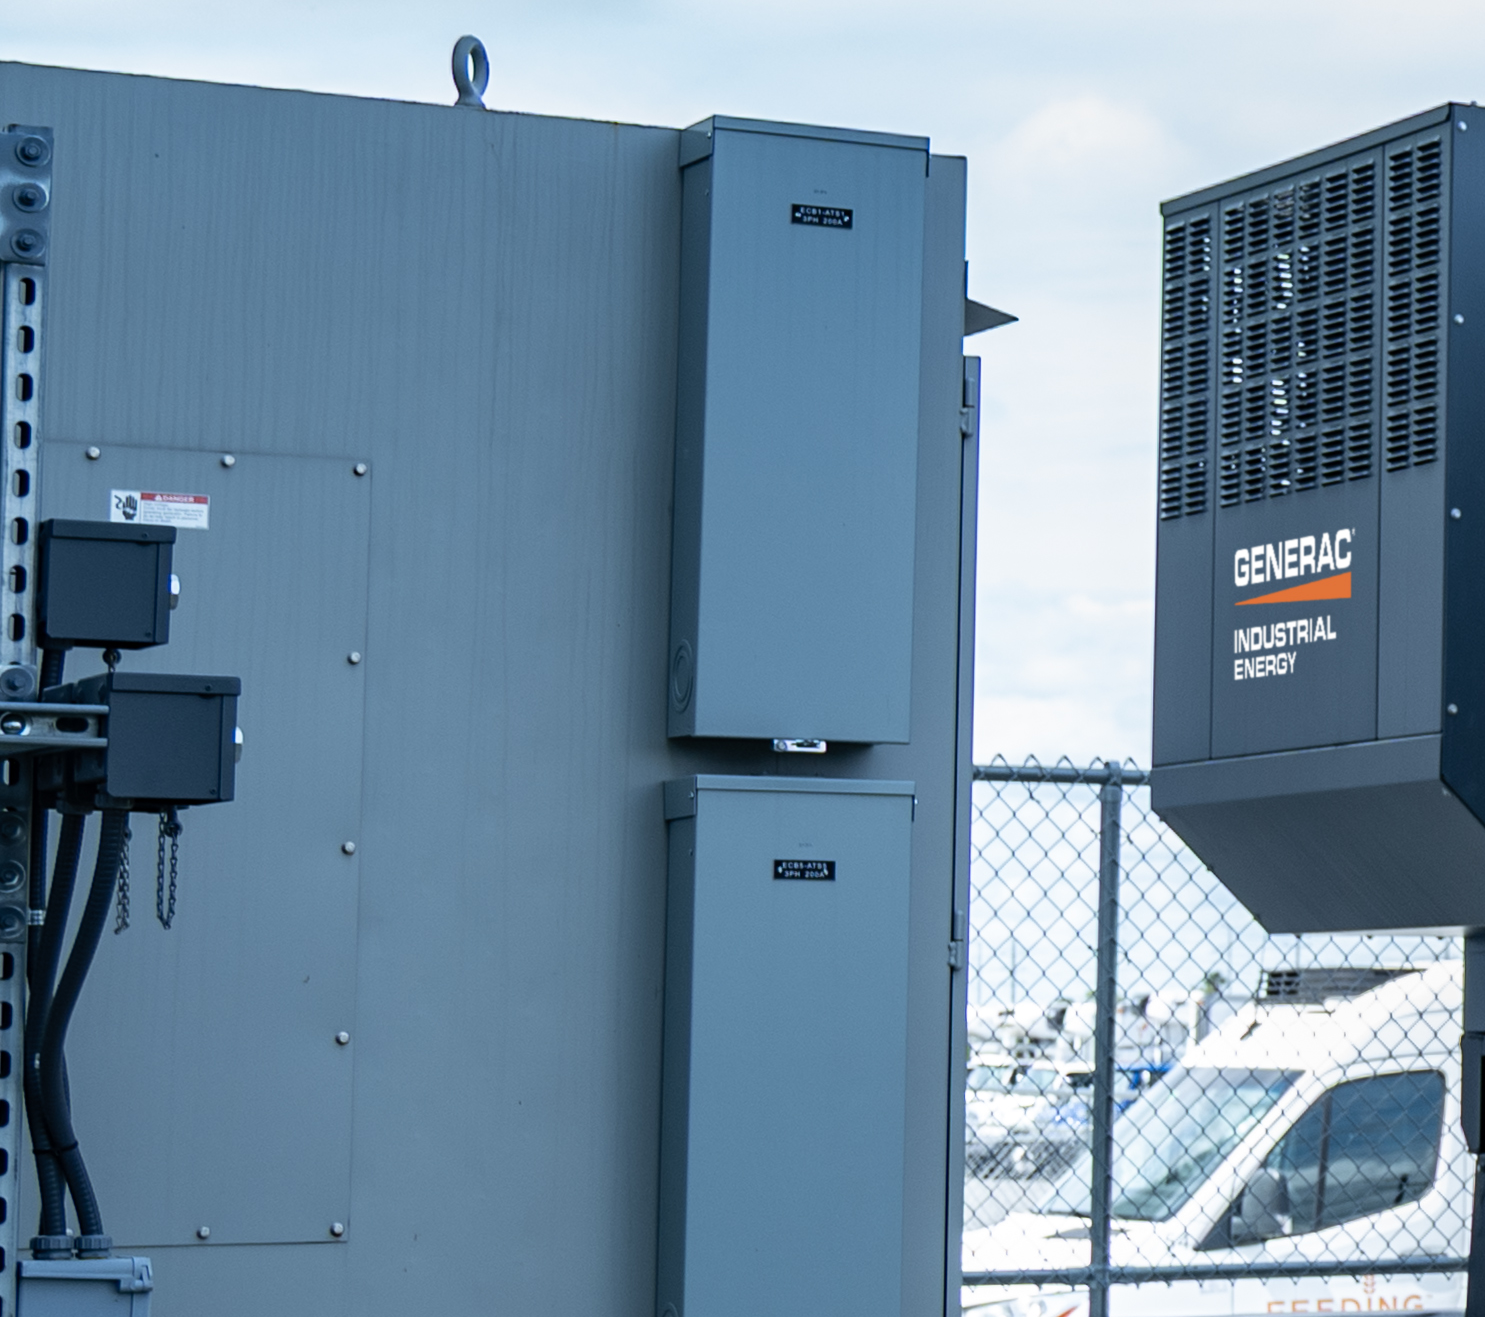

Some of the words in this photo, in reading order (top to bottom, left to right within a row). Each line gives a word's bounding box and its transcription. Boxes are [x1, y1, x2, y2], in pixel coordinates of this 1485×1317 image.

[163, 494, 195, 503] DANGER
[1234, 528, 1352, 587] GENERAC
[1234, 615, 1337, 654] INDUSTRIAL
[1234, 651, 1297, 681] ENERGY
